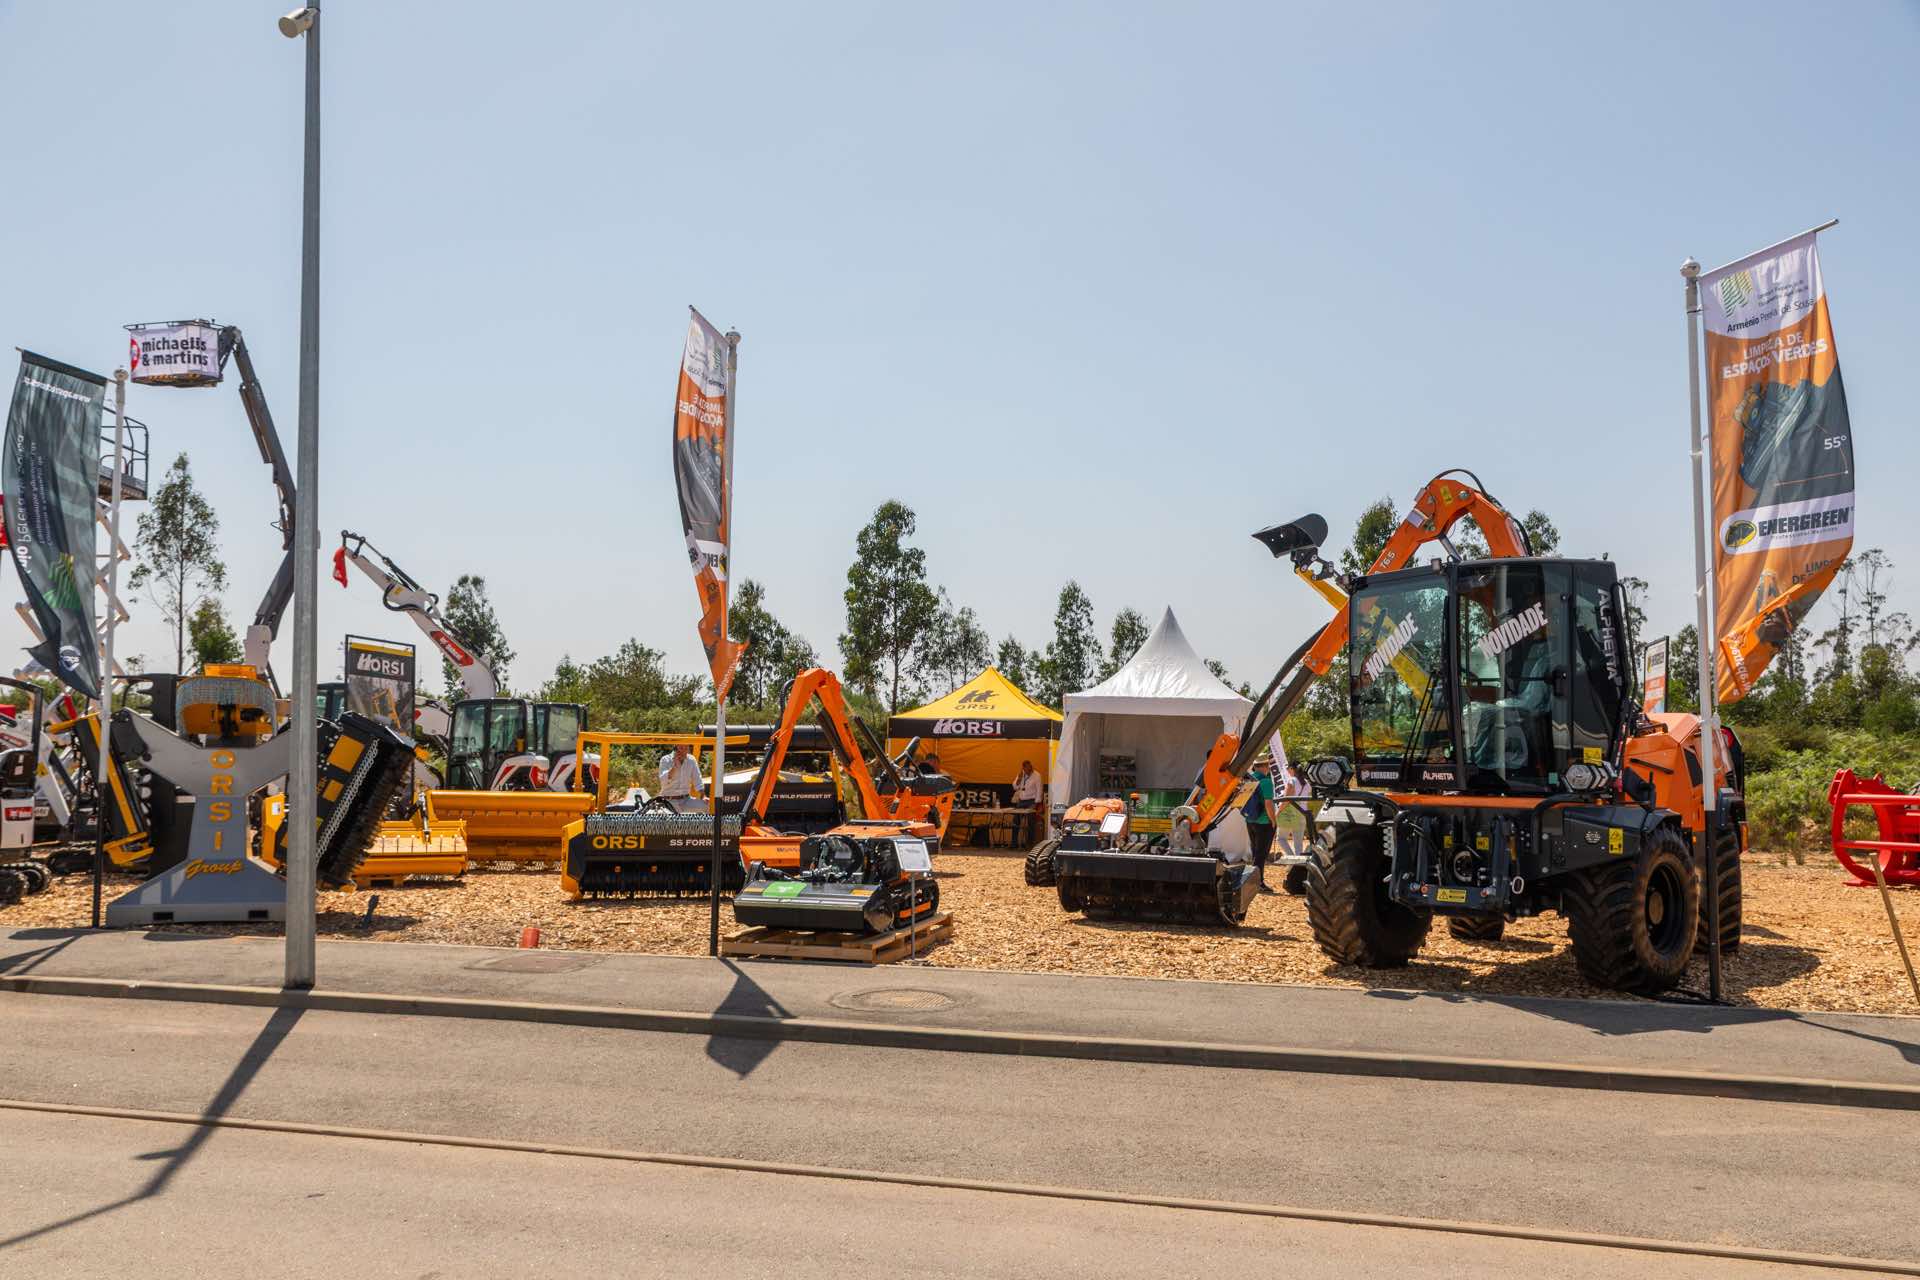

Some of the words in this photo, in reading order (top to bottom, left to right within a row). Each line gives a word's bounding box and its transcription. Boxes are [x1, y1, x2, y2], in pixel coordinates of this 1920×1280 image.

[1787, 331, 1804, 345] DE
[1771, 338, 1828, 363] VERDES
[142, 354, 150, 366] &
[153, 351, 209, 366] martins
[1759, 507, 1849, 537] ENERGREEN
[1478, 601, 1549, 660] NOVIDADE
[1365, 612, 1419, 681] NOVIDADE
[370, 658, 405, 676] ORSI
[952, 721, 1001, 735] ORSI
[723, 795, 740, 803] RSI
[592, 835, 646, 849] ORSI
[670, 839, 683, 847] SS
[685, 839, 731, 847] FORRST
